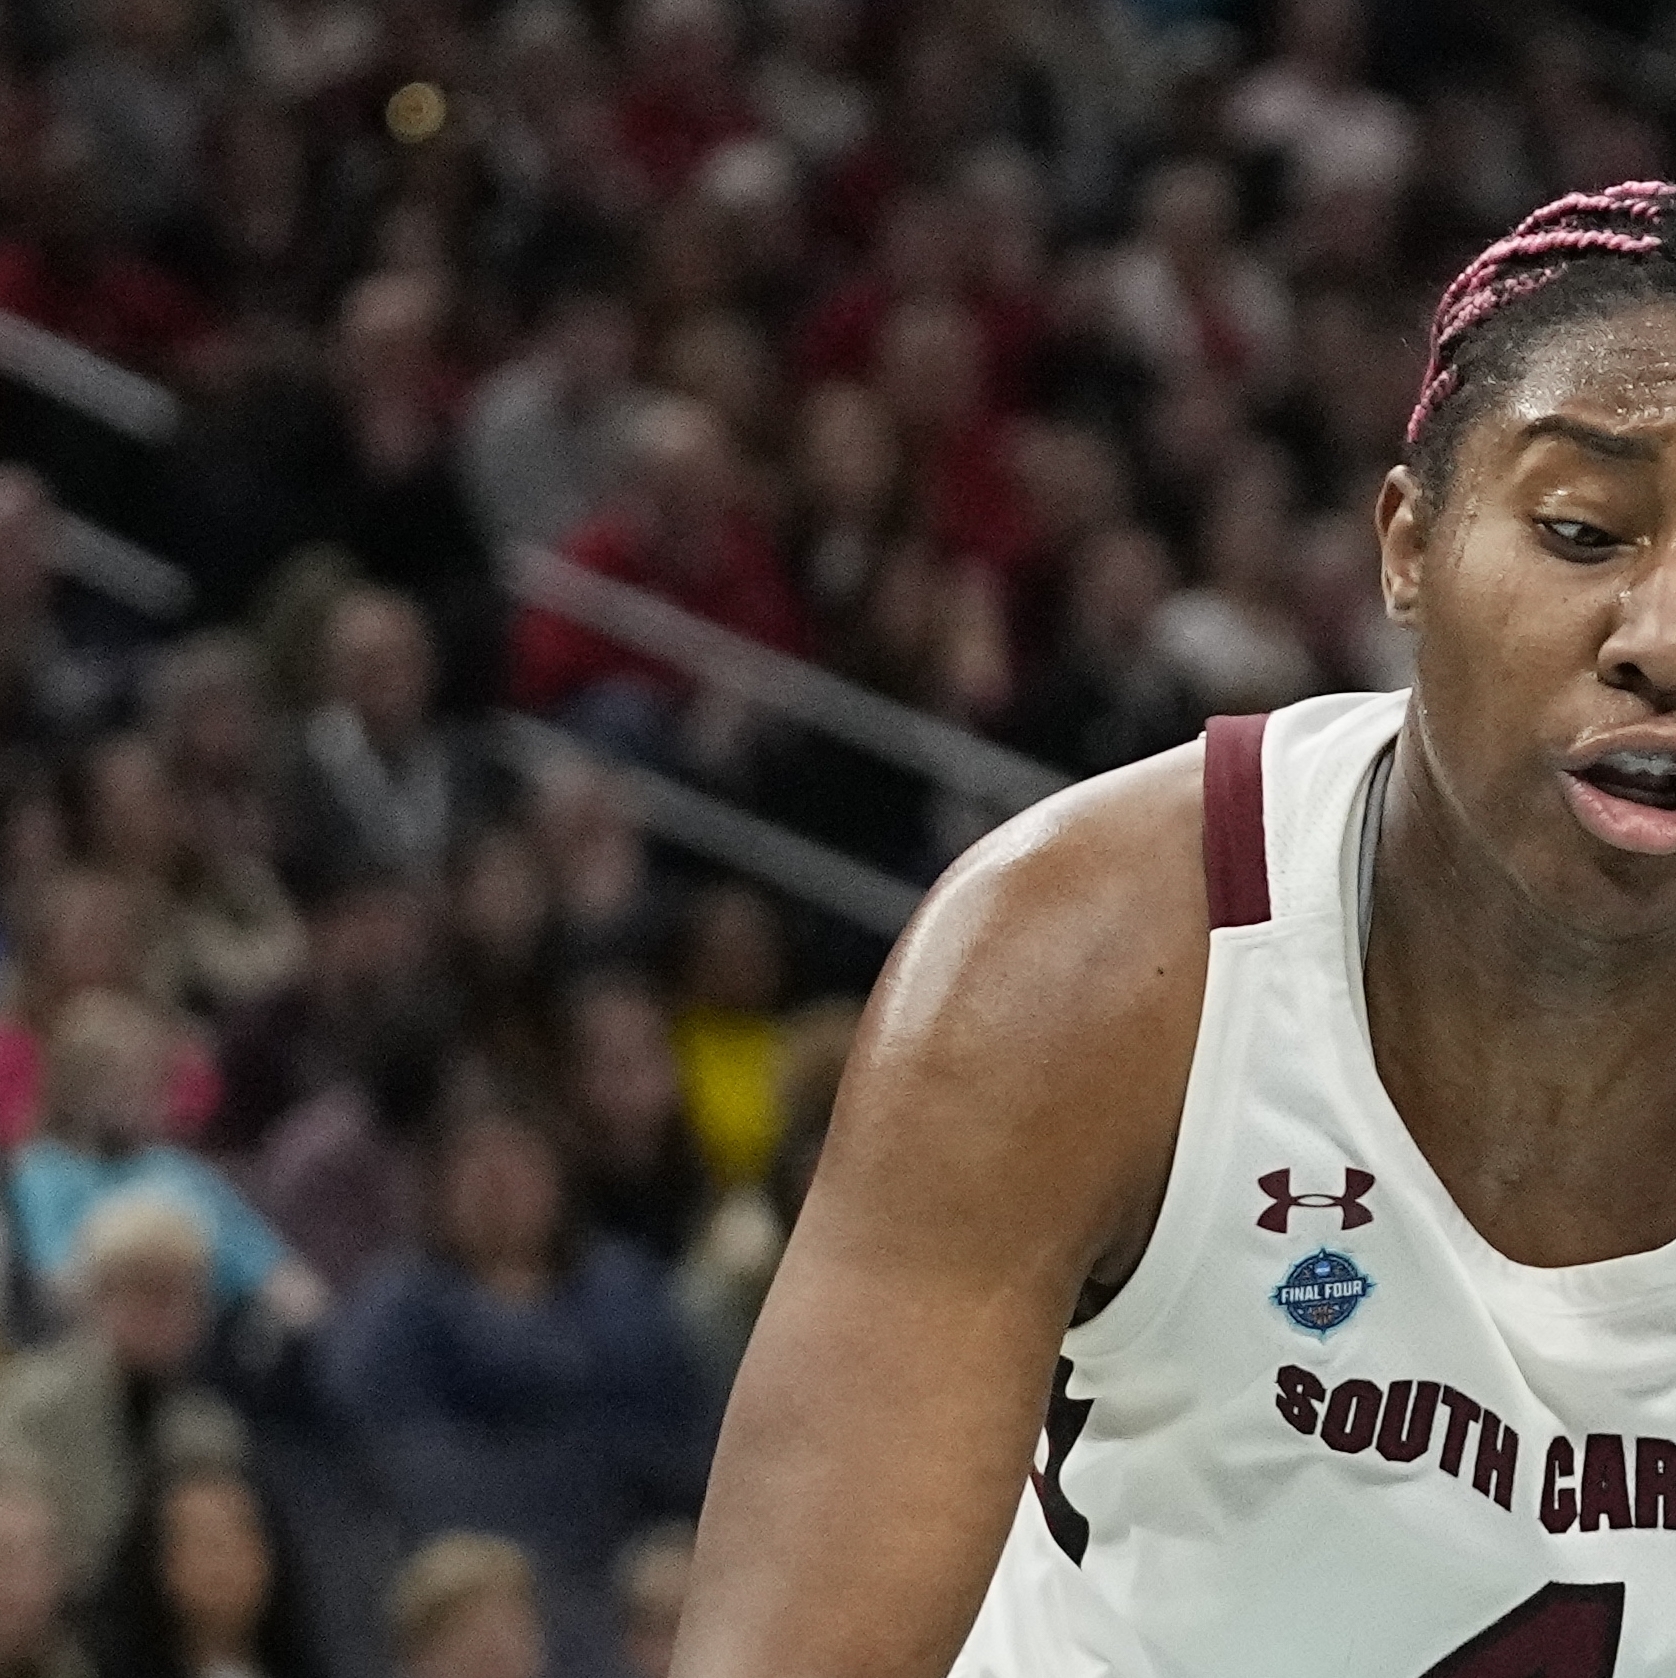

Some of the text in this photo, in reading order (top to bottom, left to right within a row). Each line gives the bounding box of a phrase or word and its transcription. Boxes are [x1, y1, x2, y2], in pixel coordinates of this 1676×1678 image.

[1281, 1280, 1363, 1303] FINAL FOUR
[1275, 1364, 1519, 1513] SOUTH
